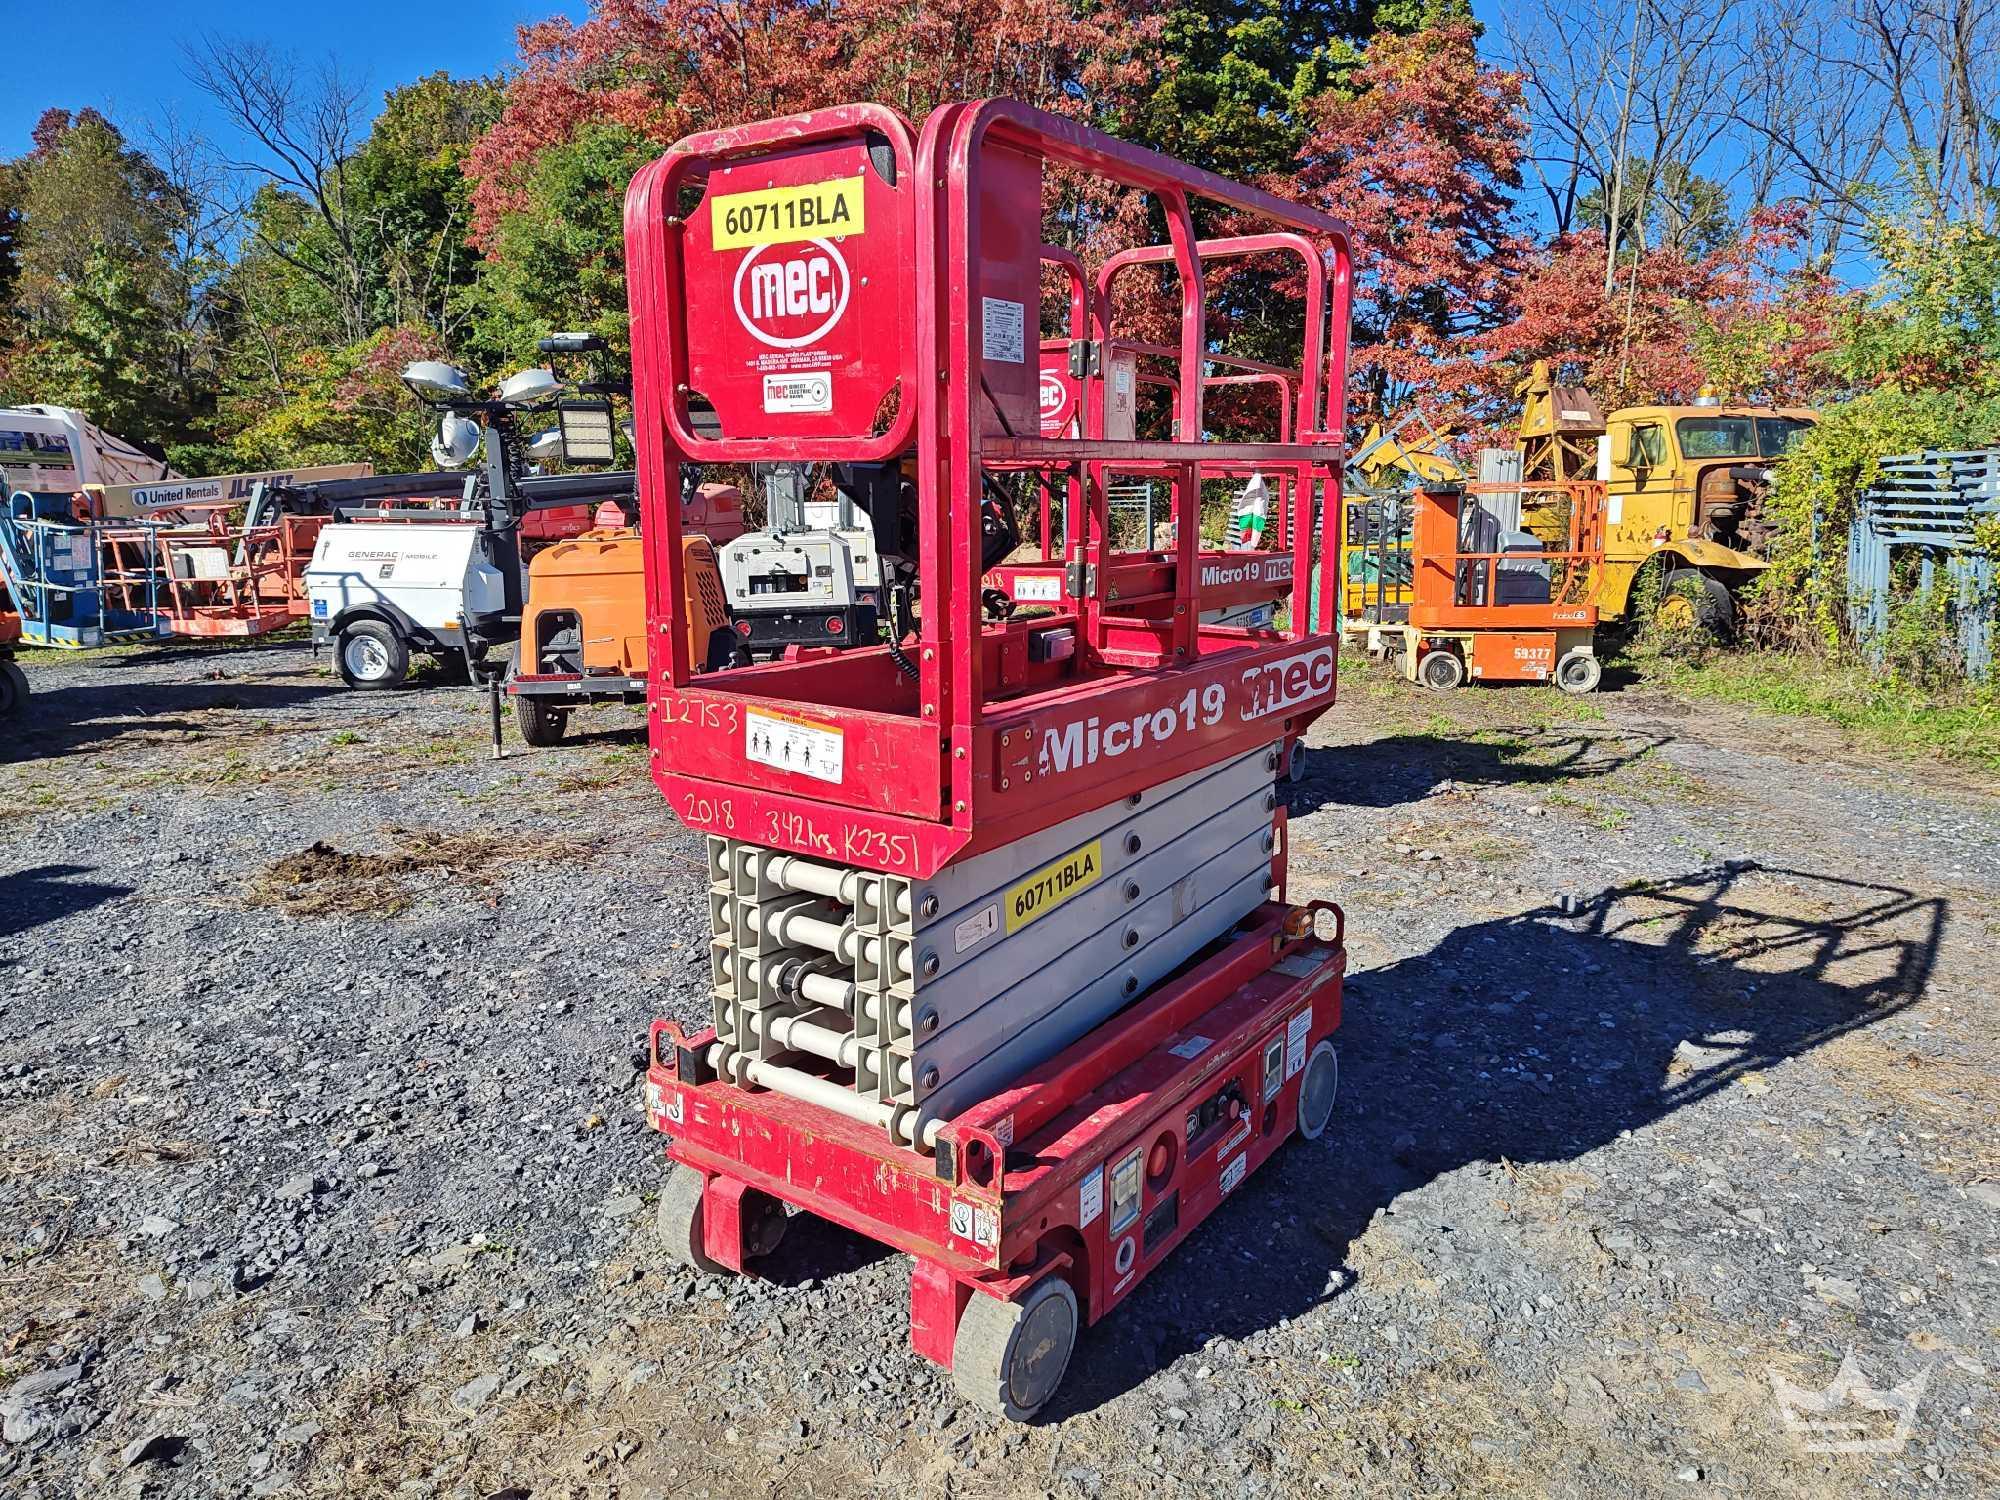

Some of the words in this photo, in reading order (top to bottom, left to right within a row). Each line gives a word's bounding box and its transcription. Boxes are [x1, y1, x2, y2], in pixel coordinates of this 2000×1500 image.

[726, 193, 850, 235] 60711BLA
[751, 257, 831, 319] mec
[1040, 385, 1059, 407] ec
[150, 489, 183, 503] United
[185, 485, 219, 499] Rentals
[1201, 563, 1259, 586] Micro19
[1514, 648, 1551, 659] 59377
[1039, 683, 1225, 776] Micro19
[683, 792, 735, 830] 2018
[1015, 854, 1094, 917] 60711BLA
